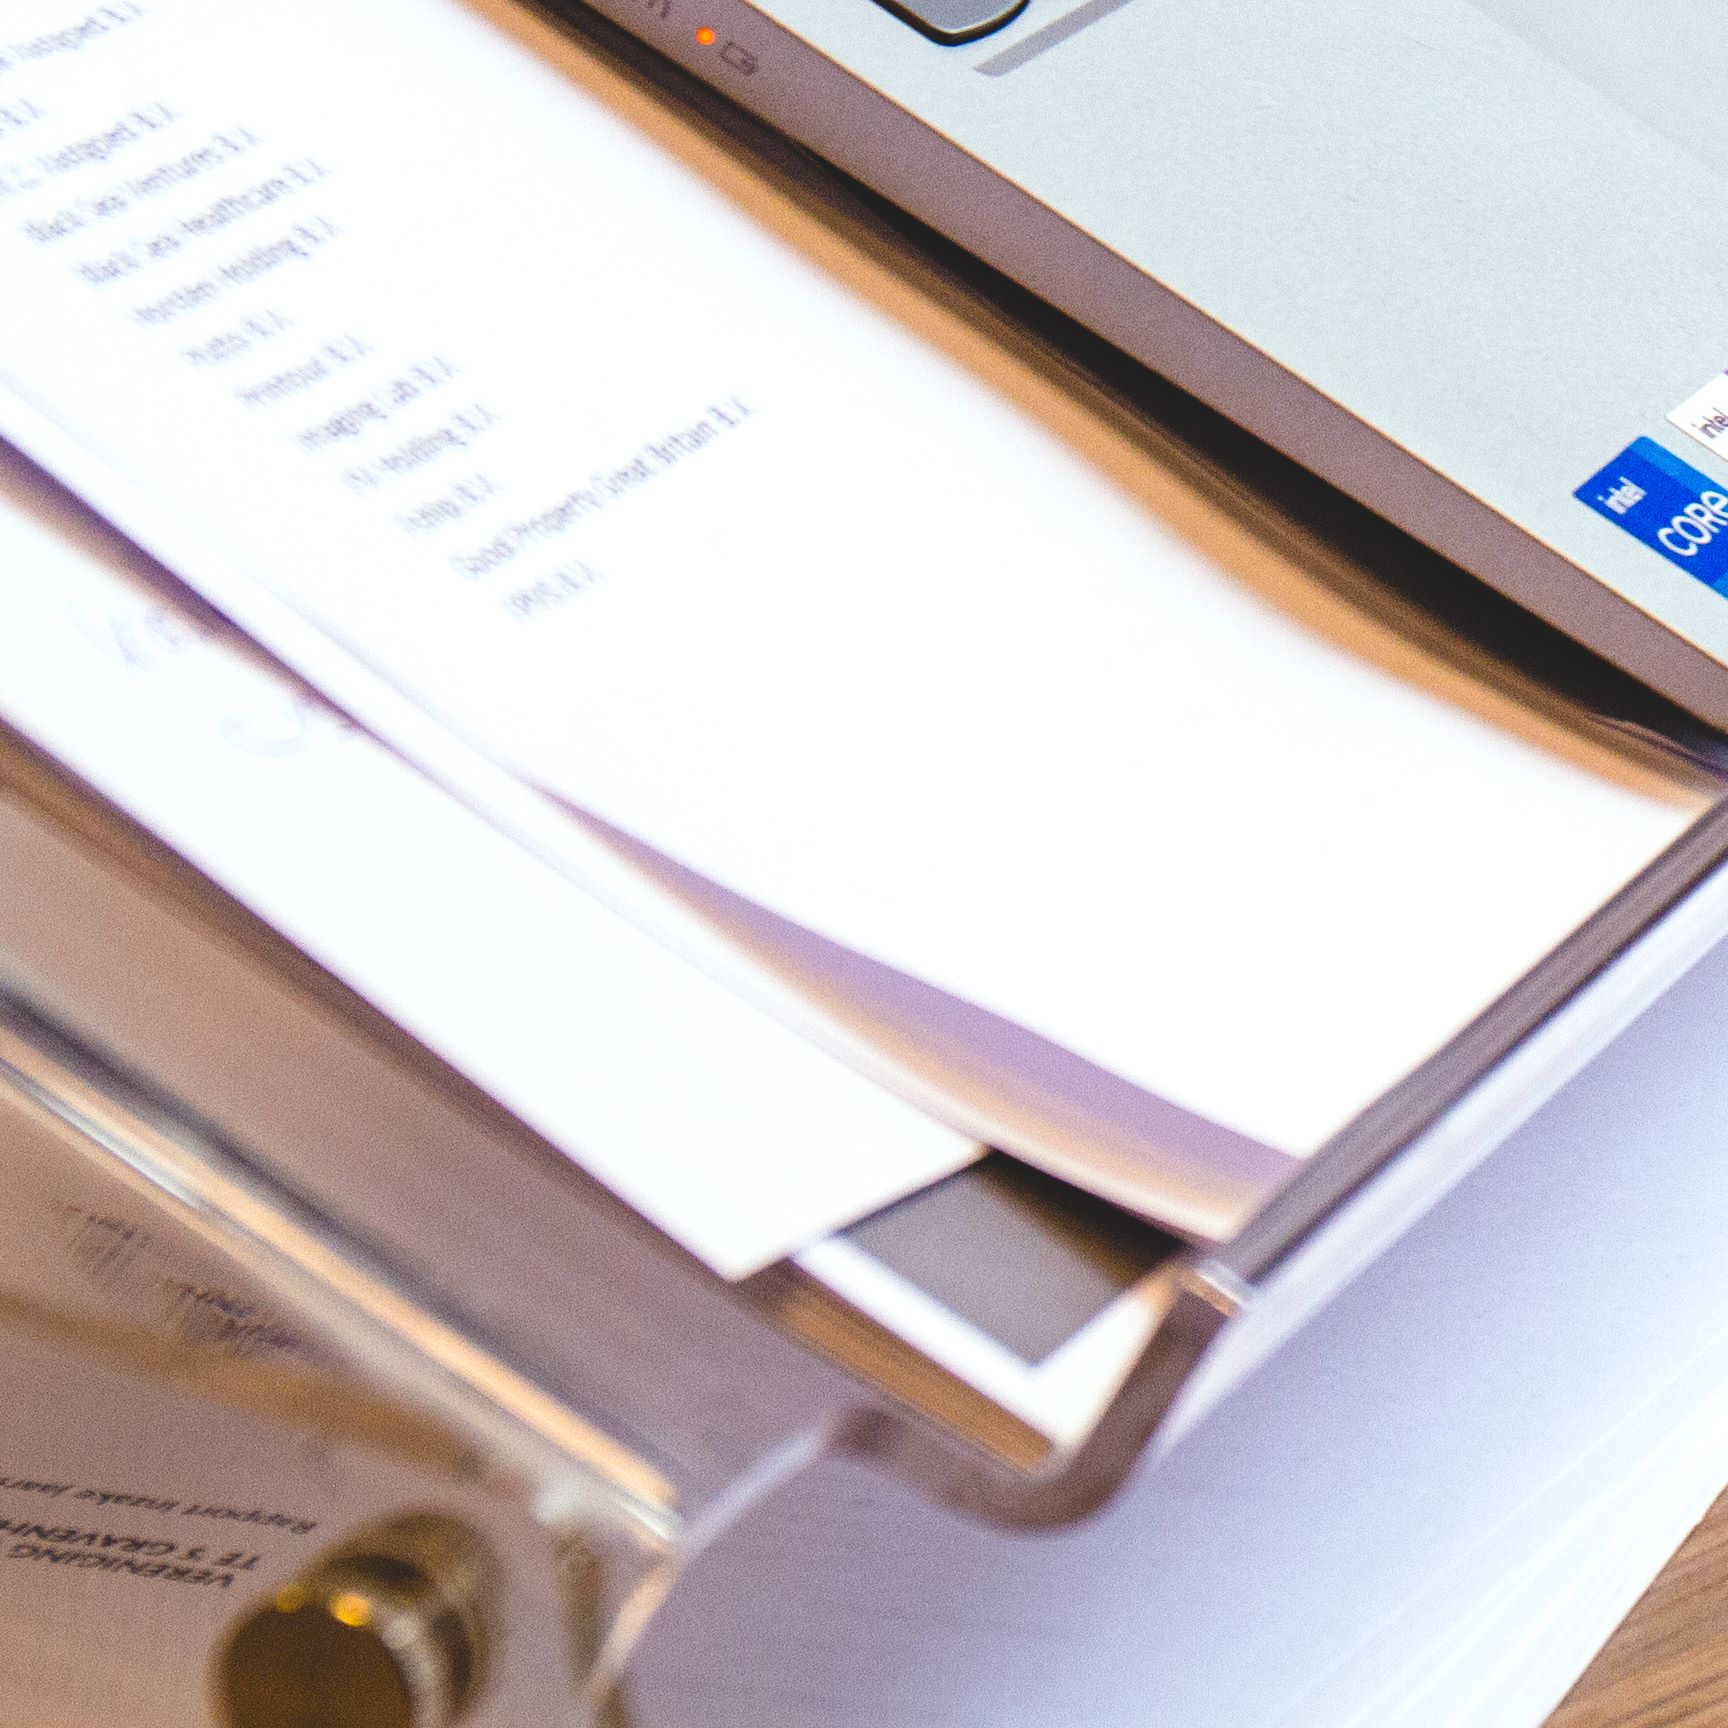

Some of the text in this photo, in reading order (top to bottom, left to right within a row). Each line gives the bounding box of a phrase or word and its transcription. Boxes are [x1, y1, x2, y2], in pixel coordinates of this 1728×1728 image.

[1597, 476, 1649, 515] intel
[74, 1488, 179, 1513] inzake
[183, 1504, 317, 1535] Rapport
[7, 1544, 235, 1589] VERENIGING
[213, 1552, 260, 1571] TE
